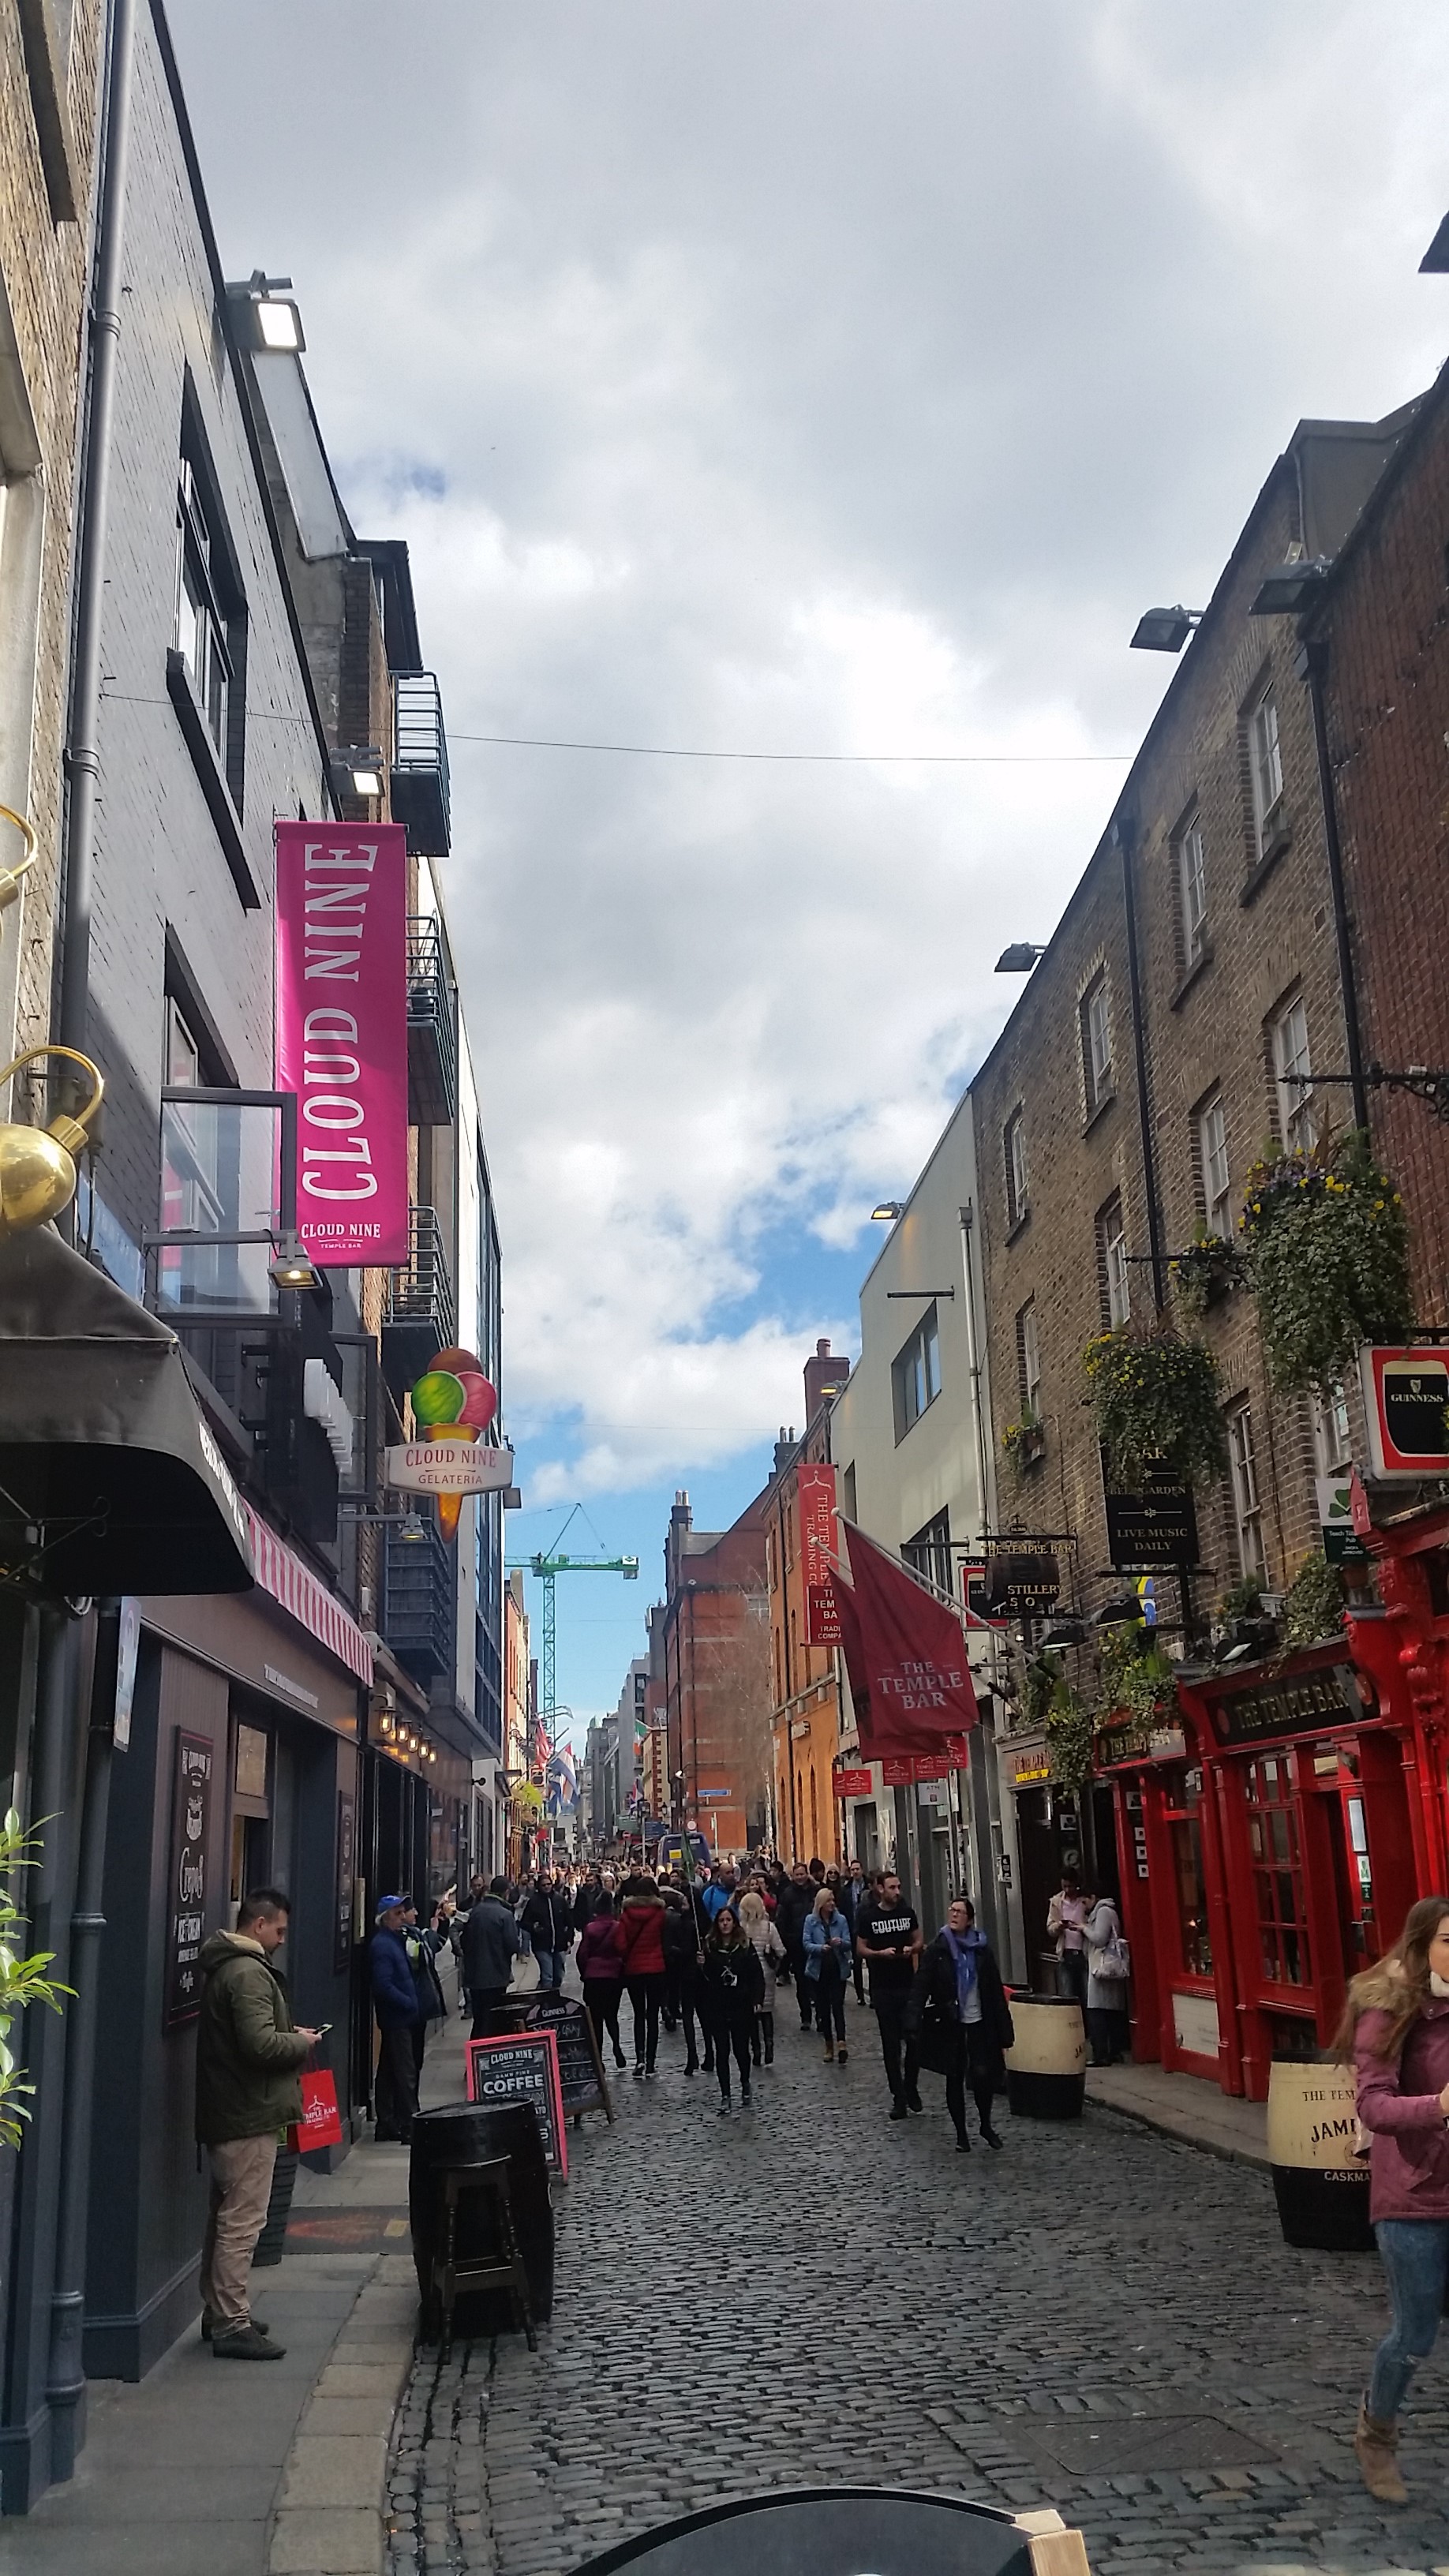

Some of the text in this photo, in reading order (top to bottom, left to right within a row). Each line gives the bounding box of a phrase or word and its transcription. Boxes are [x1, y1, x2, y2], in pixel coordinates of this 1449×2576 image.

[302, 844, 379, 1200] CLOUD NINE
[301, 1223, 381, 1239] CLOUD NINE
[1391, 1394, 1444, 1402] GUINNESS
[406, 1449, 497, 1468] CLOUD NINE
[418, 1474, 483, 1485] GELATERIA
[817, 1494, 829, 1522] THE
[1117, 1528, 1188, 1538] LIVE MUSIC
[981, 1544, 1072, 1557] THE TEMPLE BAR
[1134, 1541, 1172, 1551] DAILY
[900, 1661, 935, 1674] THE
[877, 1672, 964, 1694] TEMPLE
[901, 1692, 947, 1709] BAR
[1235, 1680, 1350, 1728] THE TEMPLE BAR
[490, 2049, 534, 2065] CLOUD NINE
[483, 2074, 545, 2095] COFFEE
[1302, 2090, 1326, 2102] THE
